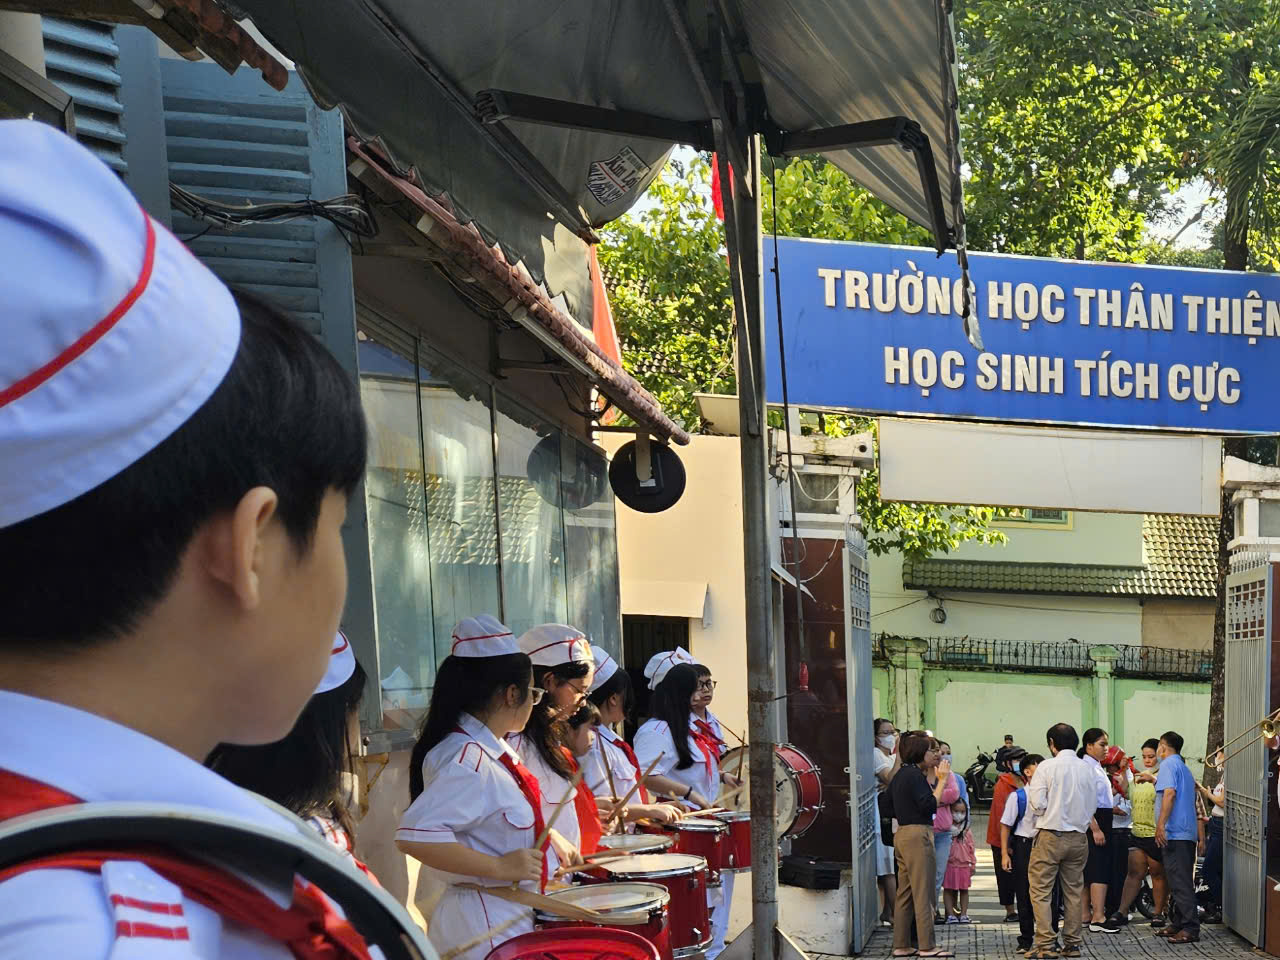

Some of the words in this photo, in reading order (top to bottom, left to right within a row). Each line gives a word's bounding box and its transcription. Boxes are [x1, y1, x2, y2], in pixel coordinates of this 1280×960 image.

[604, 154, 627, 178] Kim
[818, 261, 976, 316] TRƯỜNG
[988, 280, 1065, 331] HỌC
[1074, 282, 1173, 331] THÂN
[884, 346, 964, 397] HỌC
[976, 352, 1064, 395] SINH
[1074, 351, 1158, 400] TÍCH
[1168, 361, 1241, 411] CỰC
